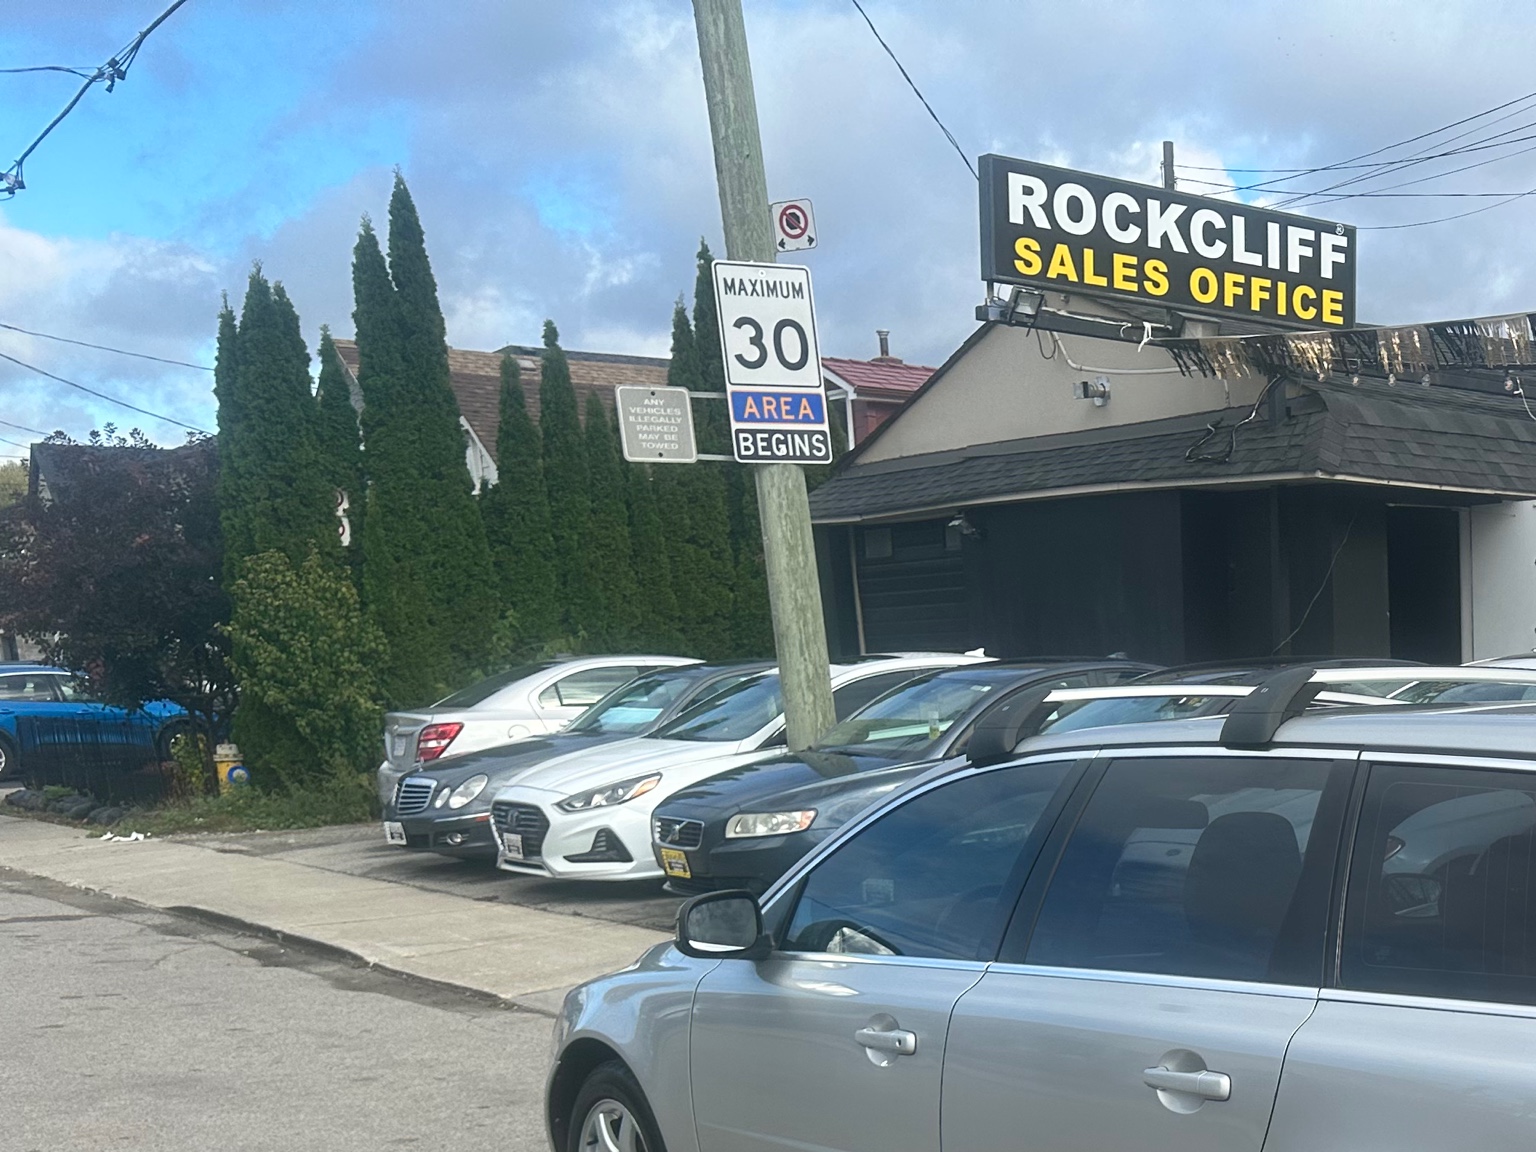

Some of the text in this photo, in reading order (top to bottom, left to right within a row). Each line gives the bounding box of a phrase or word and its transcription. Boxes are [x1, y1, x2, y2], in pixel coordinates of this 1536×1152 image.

[1007, 171, 1348, 280] ROCKCLIFF
[723, 277, 804, 299] MAXIMUM
[1013, 237, 1344, 325] SALES OFFICE
[732, 316, 809, 371] 30
[628, 407, 681, 415] VEHICLES
[628, 415, 682, 423] ILLEGALLY
[743, 396, 815, 420] AREA
[636, 424, 678, 432] PARKED
[641, 442, 679, 450] TOWED
[738, 433, 826, 457] BEGINS
